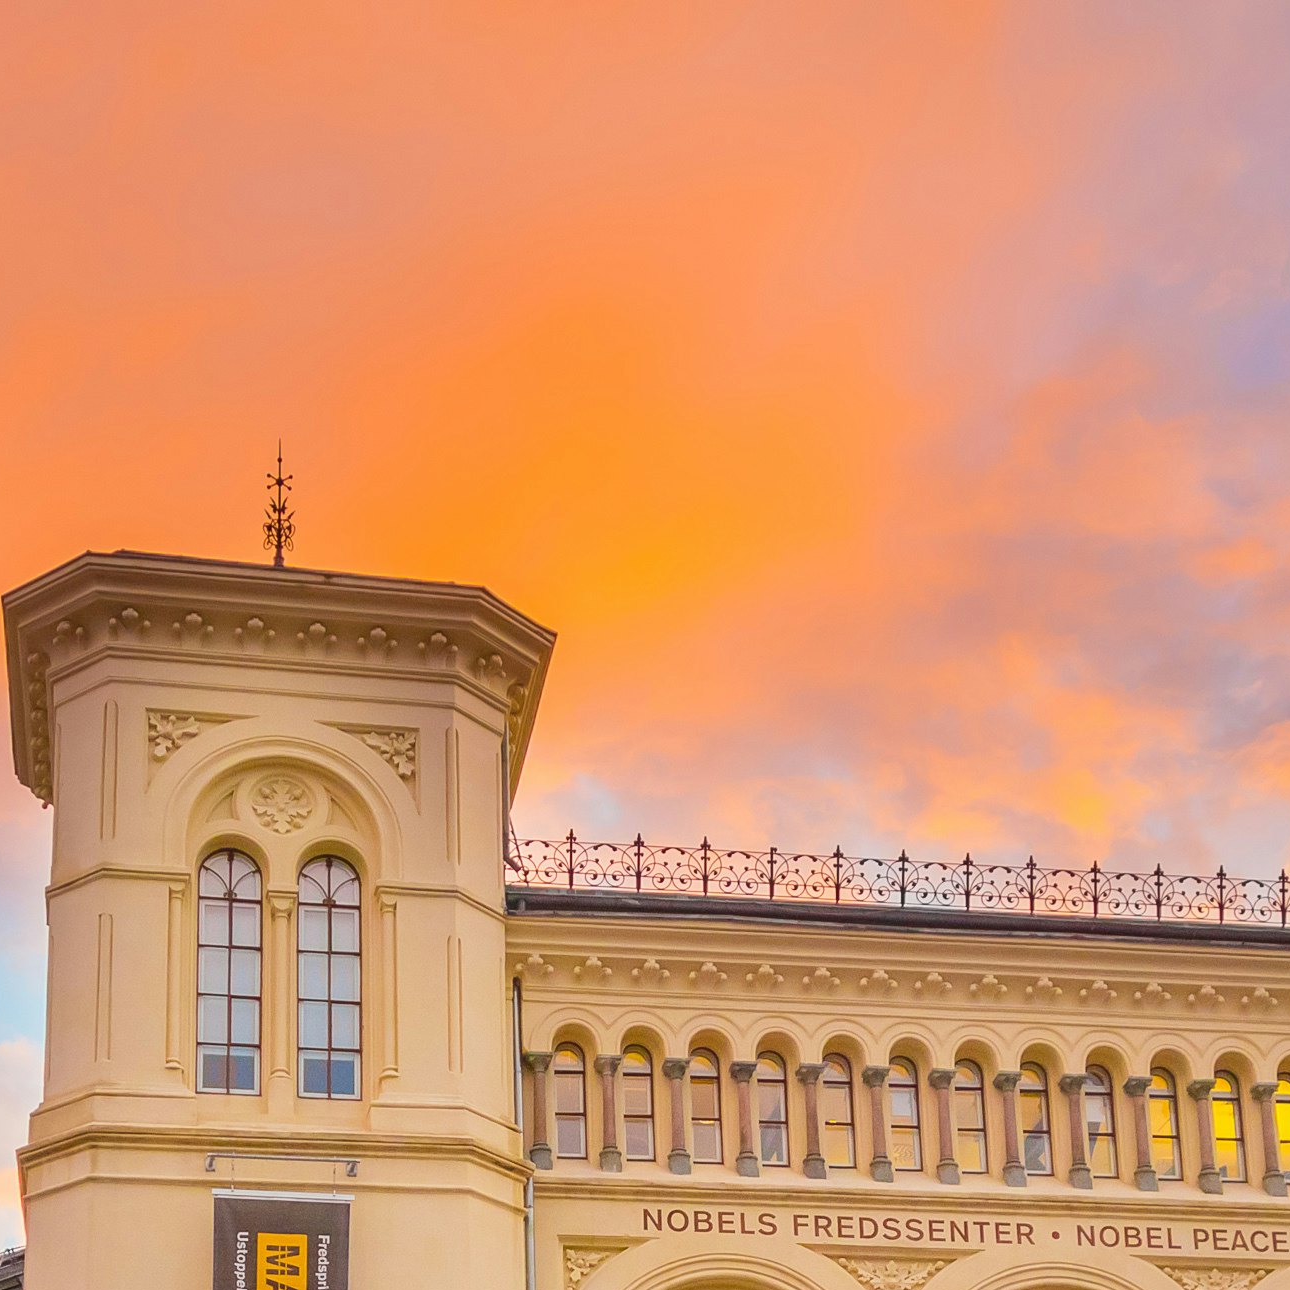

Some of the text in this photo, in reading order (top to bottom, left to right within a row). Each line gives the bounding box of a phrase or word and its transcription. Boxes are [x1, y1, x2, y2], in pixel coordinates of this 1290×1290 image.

[641, 1208, 779, 1238] NOBELS
[792, 1213, 1035, 1246] FREDSSENTER
[1076, 1225, 1183, 1251] NOBEL
[1192, 1227, 1290, 1255] PEACE
